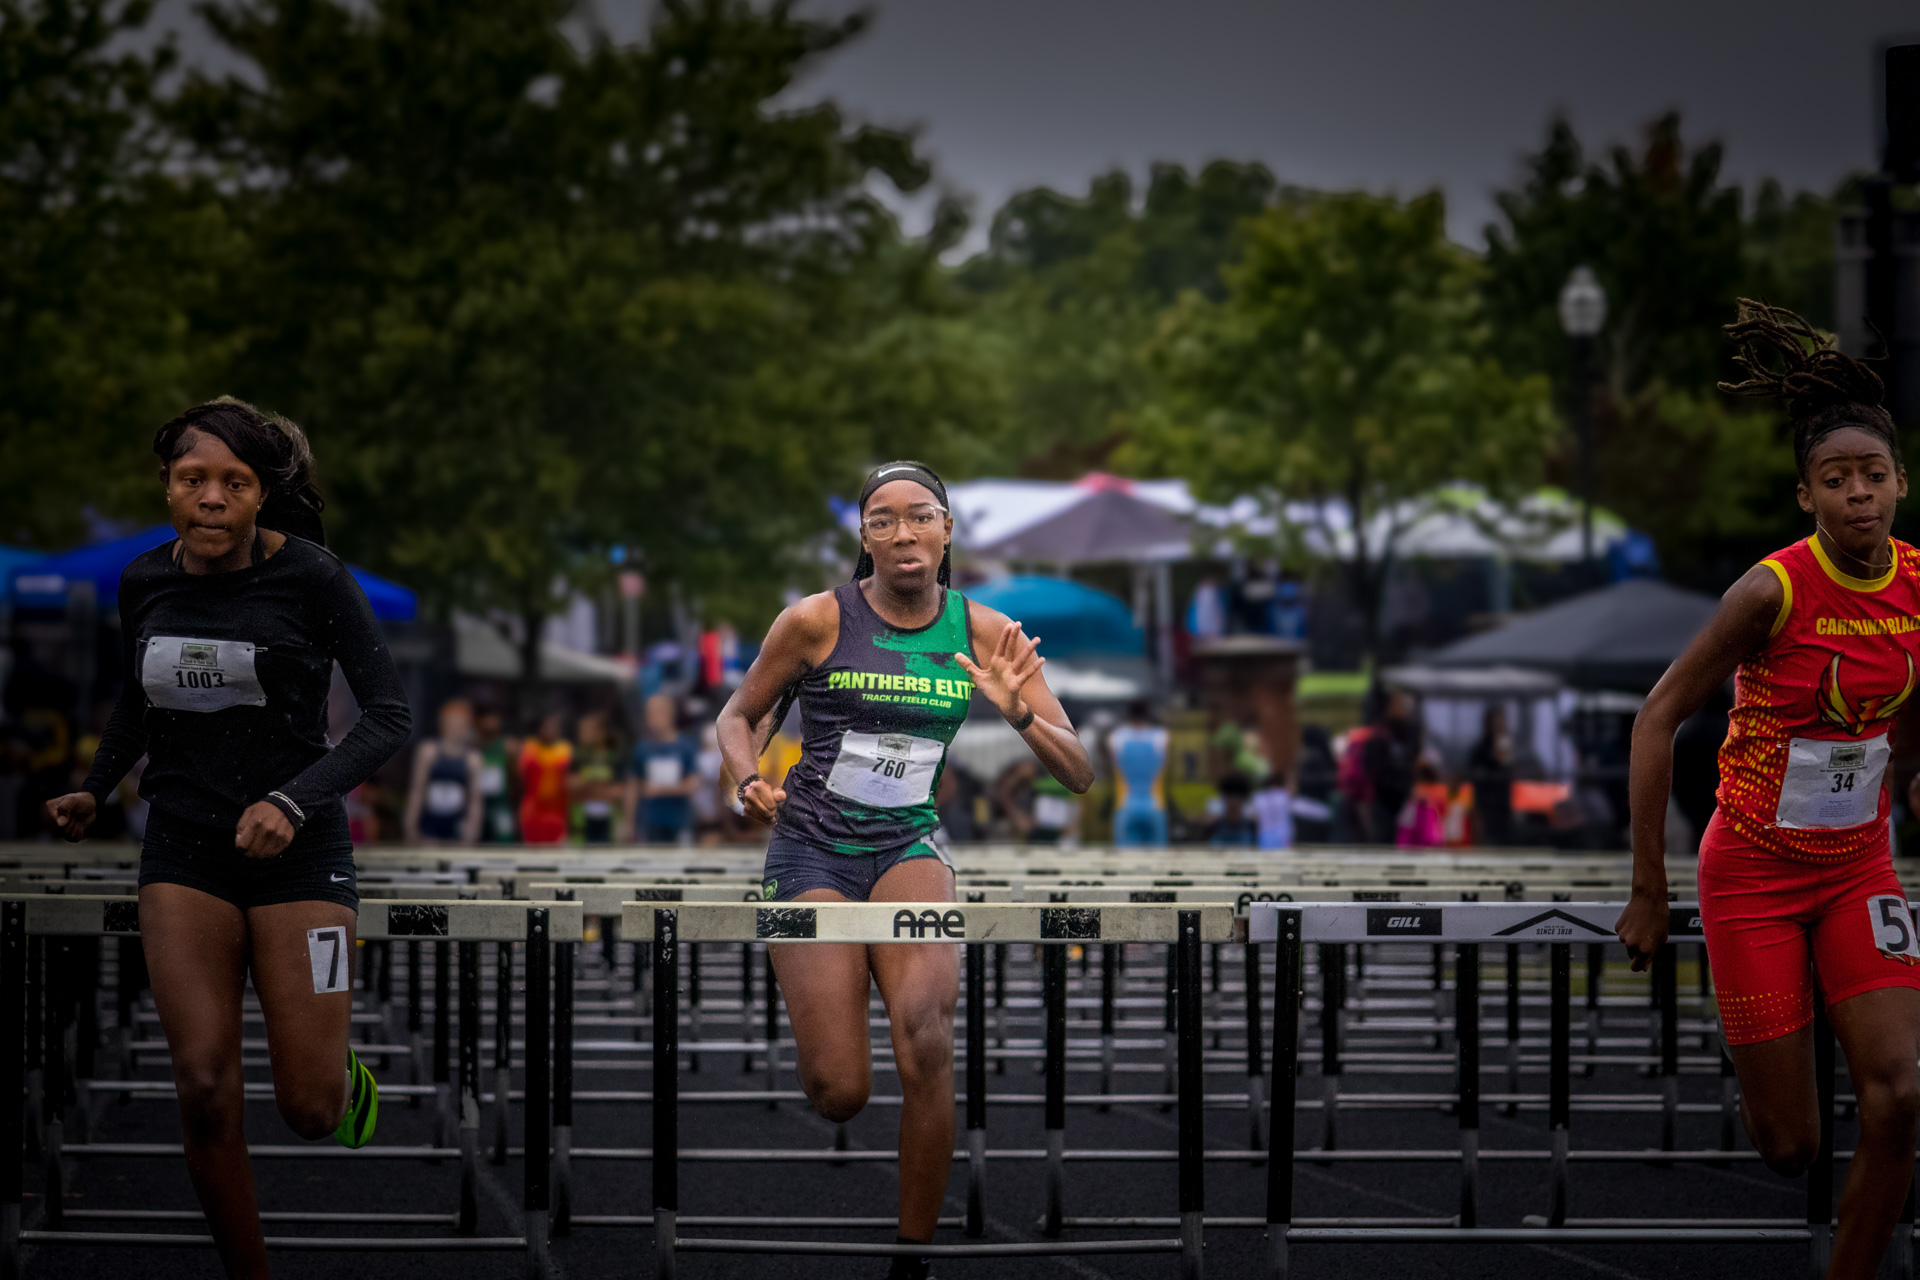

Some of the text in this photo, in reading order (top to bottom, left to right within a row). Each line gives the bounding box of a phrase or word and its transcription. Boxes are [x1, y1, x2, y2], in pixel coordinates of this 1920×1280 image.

[1816, 617, 1888, 636] CAROLINA
[175, 670, 226, 689] 1003
[828, 671, 931, 693] PANTHERS
[861, 693, 892, 702] TRACK
[901, 695, 928, 705] FIELD
[928, 698, 952, 709] CLUB
[871, 756, 906, 779] 760
[1831, 772, 1855, 793] 34
[1387, 916, 1421, 928] GILL
[1878, 898, 1910, 952] 5
[317, 930, 340, 988] 7
